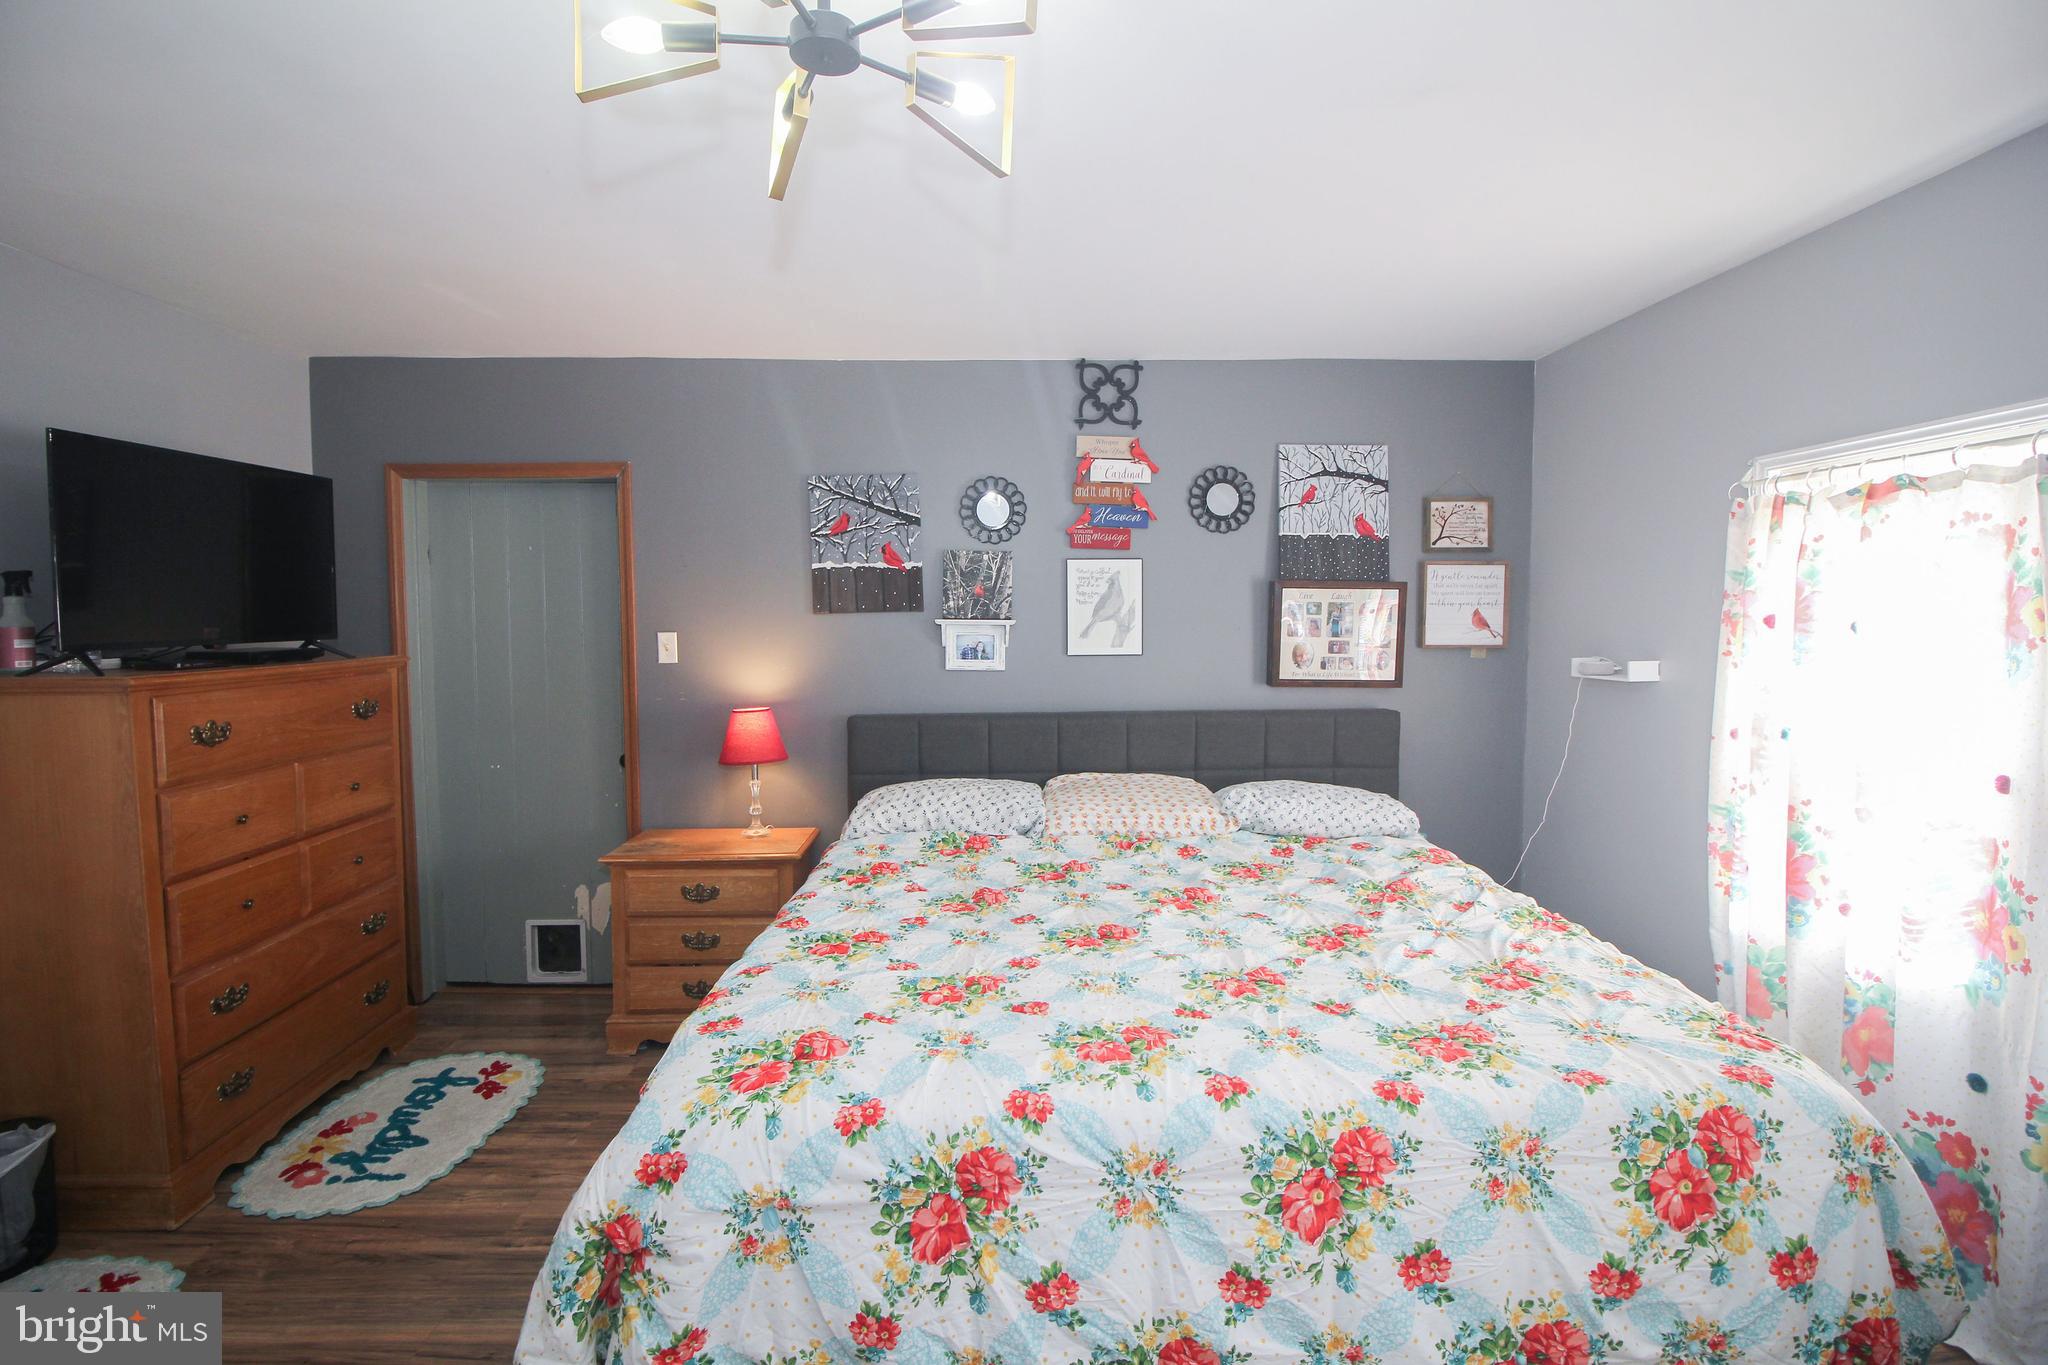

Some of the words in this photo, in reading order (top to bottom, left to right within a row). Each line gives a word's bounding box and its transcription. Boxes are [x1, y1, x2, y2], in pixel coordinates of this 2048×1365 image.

[1104, 465, 1144, 480] Cardinal
[1075, 486, 1088, 497] and
[1090, 486, 1096, 497] it
[1099, 486, 1111, 498] will
[1112, 487, 1122, 501] fly
[1124, 487, 1132, 498] to
[1094, 507, 1142, 524] Heaven
[1073, 533, 1092, 544] YOUR
[1091, 532, 1128, 548] message
[1331, 592, 1352, 600] Laugh
